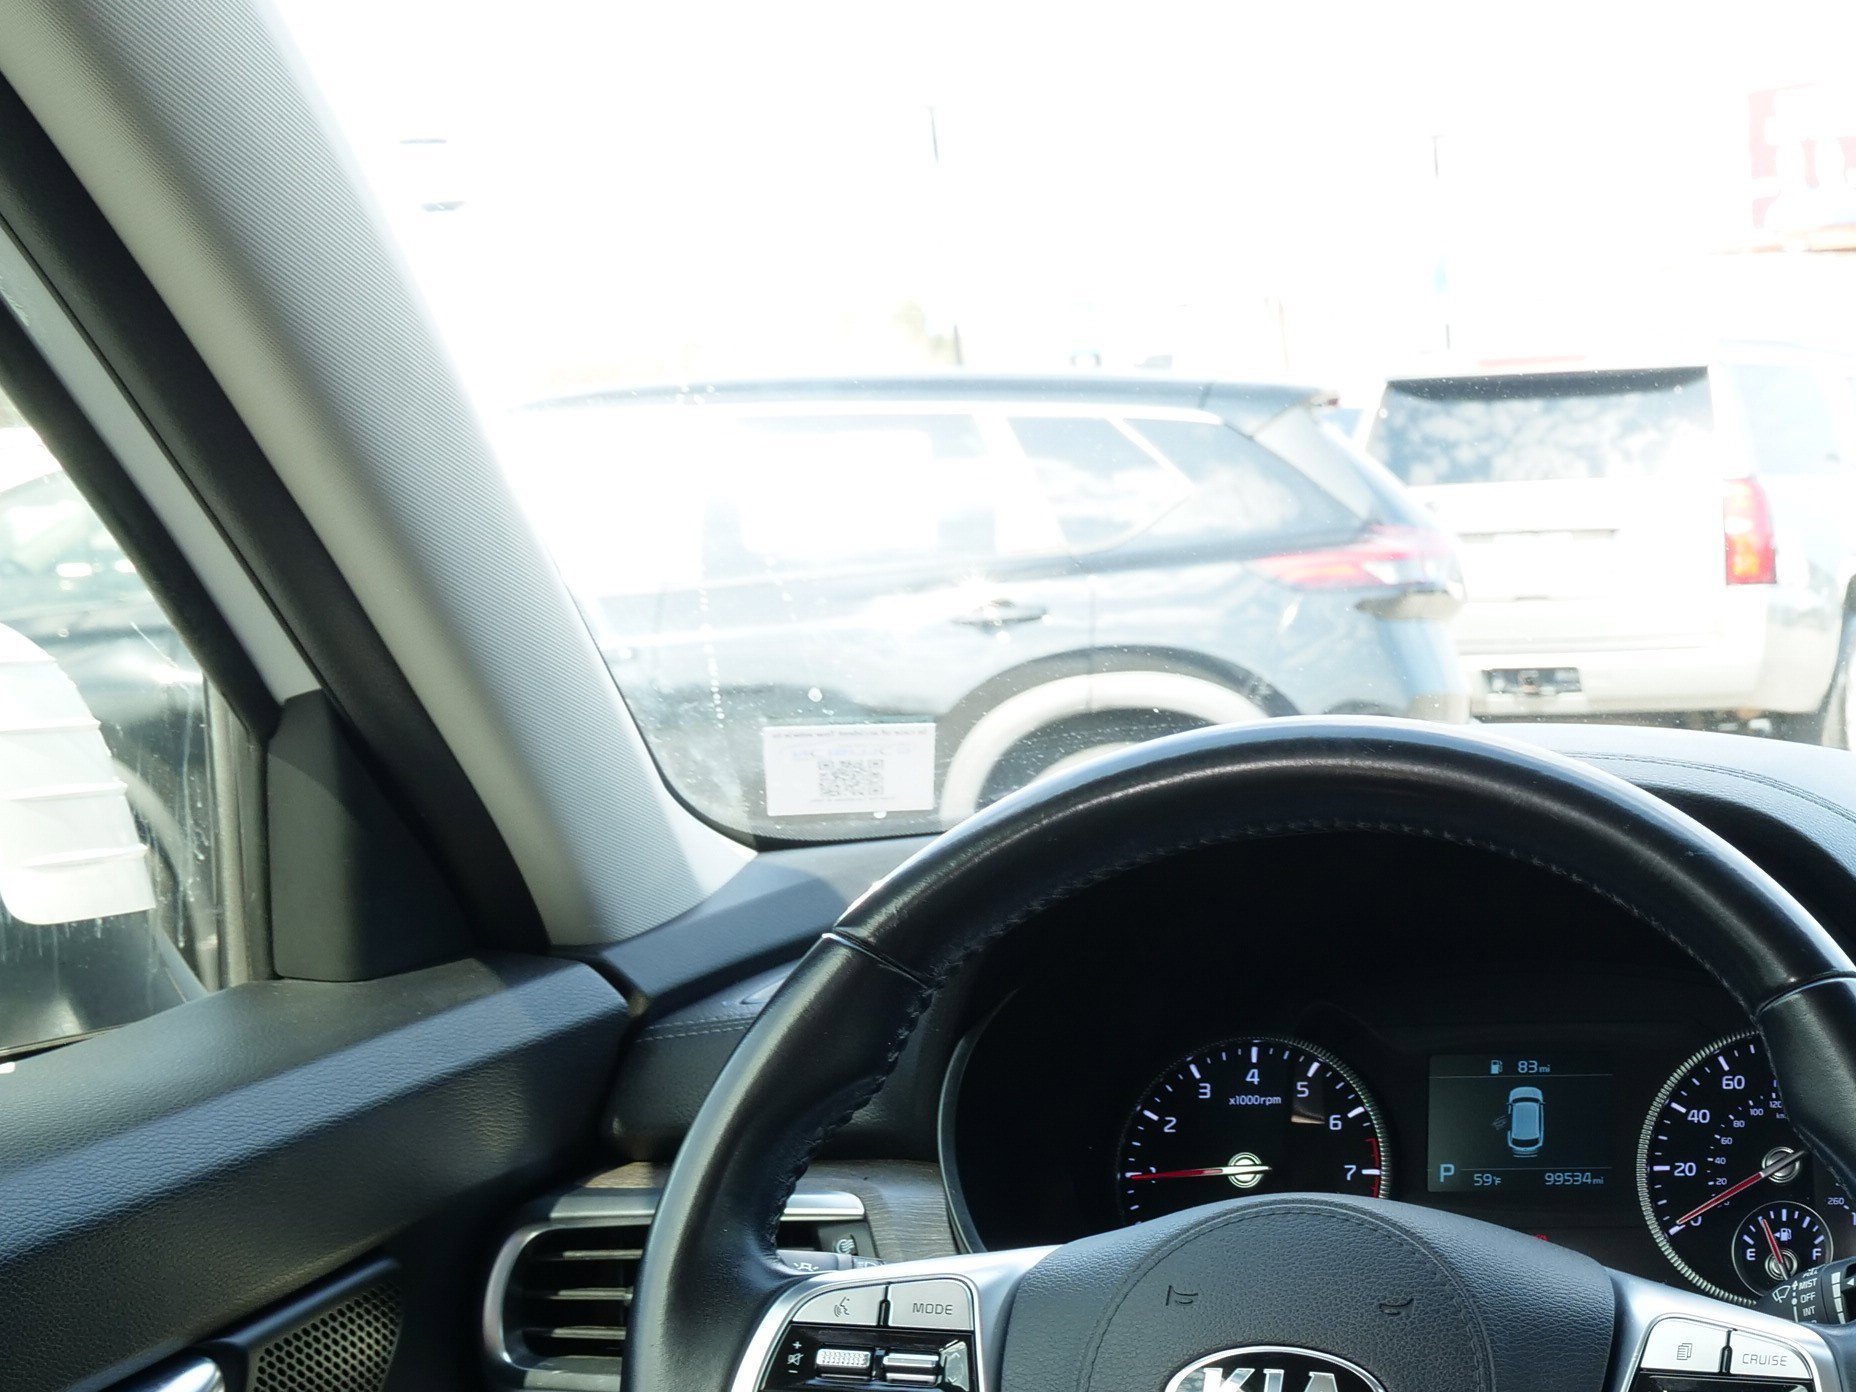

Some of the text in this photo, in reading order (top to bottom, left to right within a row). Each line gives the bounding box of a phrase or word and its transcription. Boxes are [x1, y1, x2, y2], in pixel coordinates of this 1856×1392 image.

[1245, 1068, 1260, 1085] 4
[1722, 1075, 1745, 1090] 60
[1198, 1083, 1211, 1098] 3
[1296, 1082, 1309, 1098] 5
[1228, 1094, 1282, 1106] x1000rpm
[1687, 1109, 1710, 1124] 40
[1750, 1108, 1764, 1116] 100
[1164, 1117, 1177, 1133] 2
[1329, 1115, 1342, 1130] 6
[1733, 1120, 1745, 1128] 80
[1721, 1137, 1733, 1145] 60
[1714, 1157, 1726, 1165] 40
[1344, 1165, 1357, 1181] 7
[1439, 1163, 1455, 1183] P
[1674, 1162, 1697, 1176] 20
[1716, 1178, 1727, 1186] 20
[1827, 1197, 1845, 1205] 260
[1746, 1248, 1757, 1261] E
[1812, 1248, 1822, 1260] F
[1798, 1278, 1818, 1290] MIST
[1800, 1292, 1816, 1303] OFF
[912, 1302, 954, 1316] MODE
[1802, 1305, 1816, 1317] INT
[1742, 1353, 1788, 1367] CRUISE
